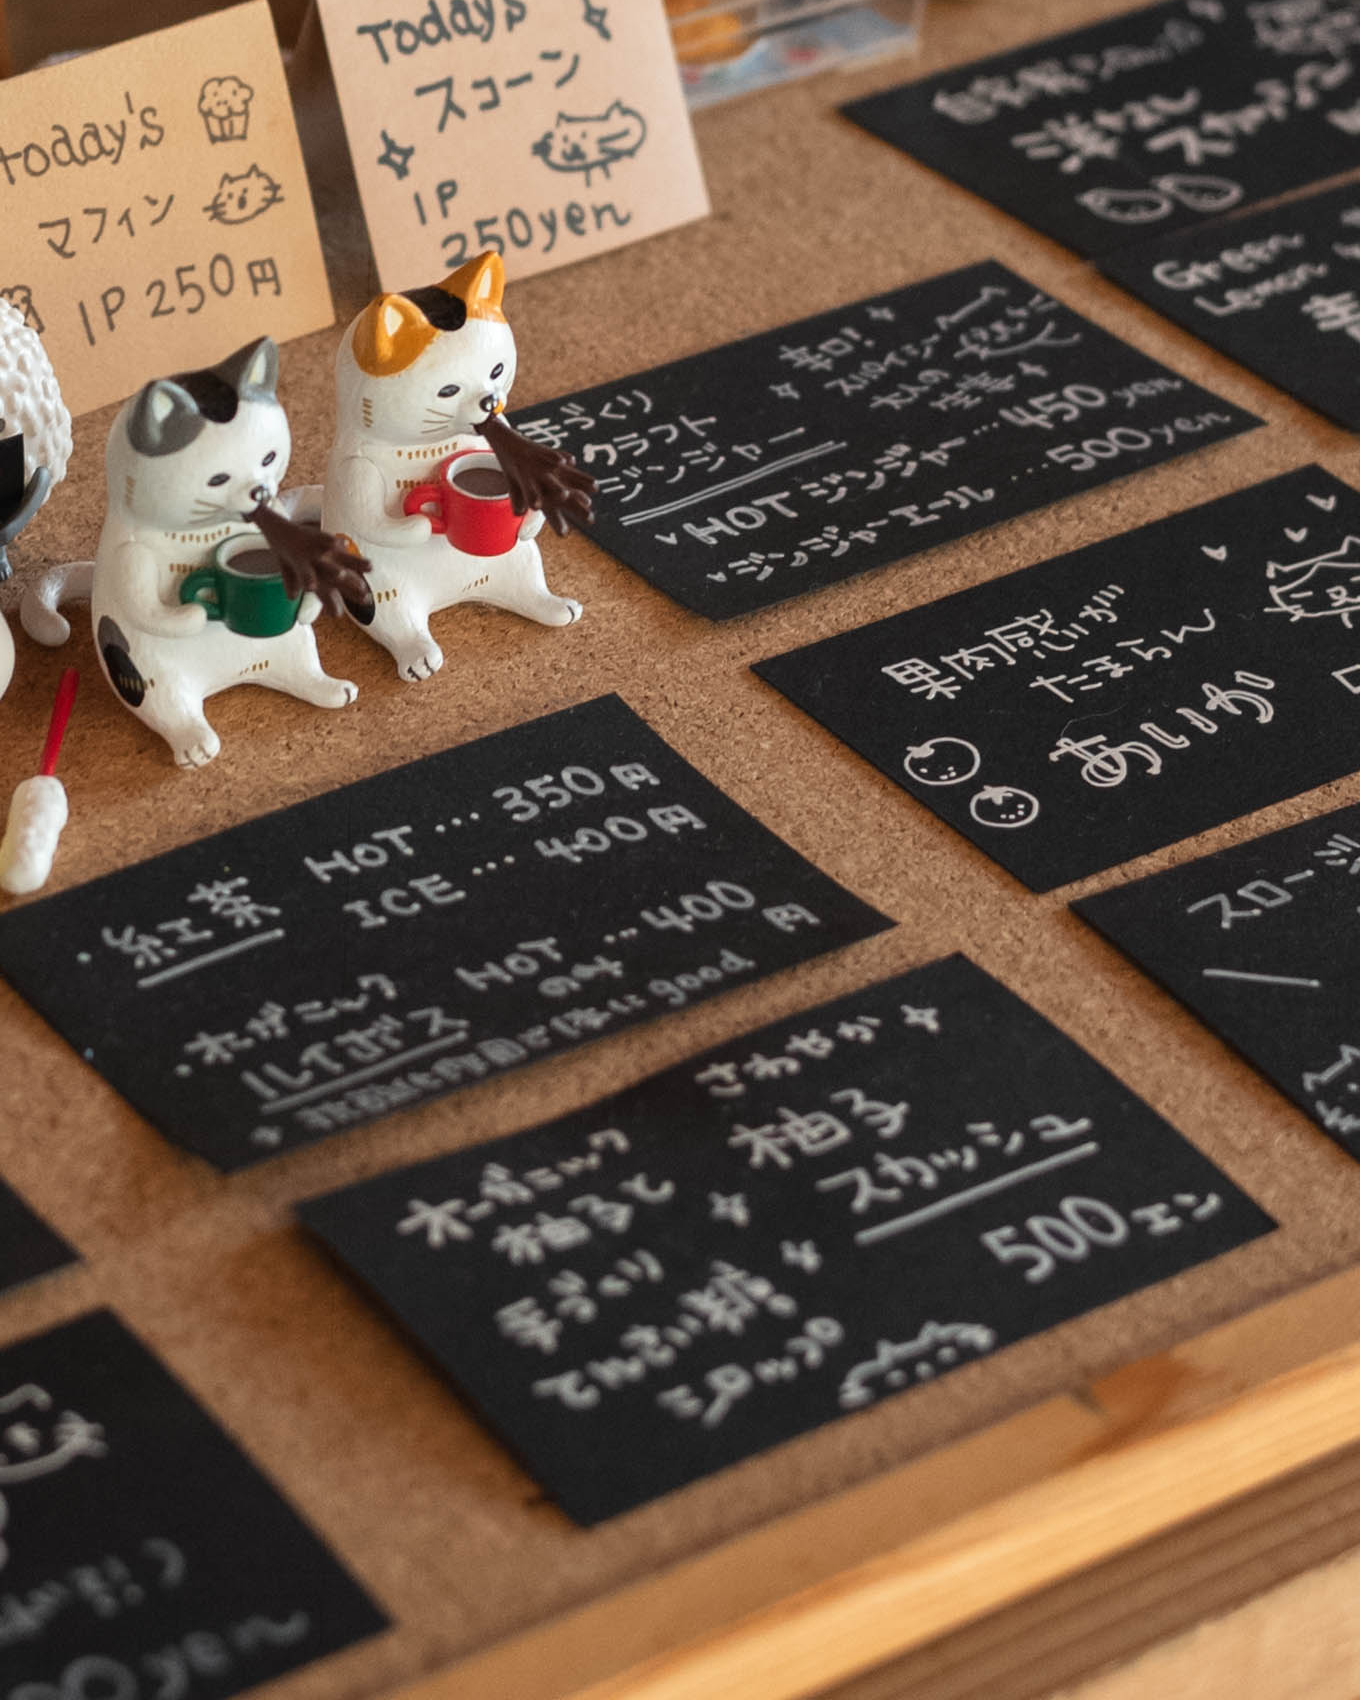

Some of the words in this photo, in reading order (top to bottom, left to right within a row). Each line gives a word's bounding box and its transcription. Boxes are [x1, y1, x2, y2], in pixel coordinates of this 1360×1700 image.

[414, 51, 580, 133] スコーン
[38, 194, 174, 259] マフィン
[441, 201, 632, 261] 250yen
[1152, 235, 1302, 289] Green
[145, 253, 282, 318] 250円
[1194, 264, 1327, 316] Lemon
[515, 388, 654, 450] 手づくり
[582, 415, 717, 466] クラフト
[592, 426, 805, 503] ジンジャー
[682, 491, 798, 545] HOT
[800, 436, 966, 504] ジンジャー
[727, 485, 995, 581] ジンジャーエール
[880, 584, 1125, 701] 果肉感が
[1029, 607, 1216, 704] たまらん
[102, 876, 281, 969] 紅茶
[303, 825, 414, 883] HOT
[343, 873, 466, 928] ICE
[455, 936, 563, 991] HOT
[538, 955, 623, 997] のみ
[242, 1006, 470, 1100] ルイボス
[696, 1015, 881, 1095] さわやか
[729, 1088, 909, 1167] 柚子
[818, 1114, 1091, 1212] スカッシュ
[398, 1129, 629, 1247] オーガニック
[493, 1173, 674, 1263] 柚子と
[497, 1250, 667, 1351] 手づくり
[660, 1316, 847, 1426] シロップ
